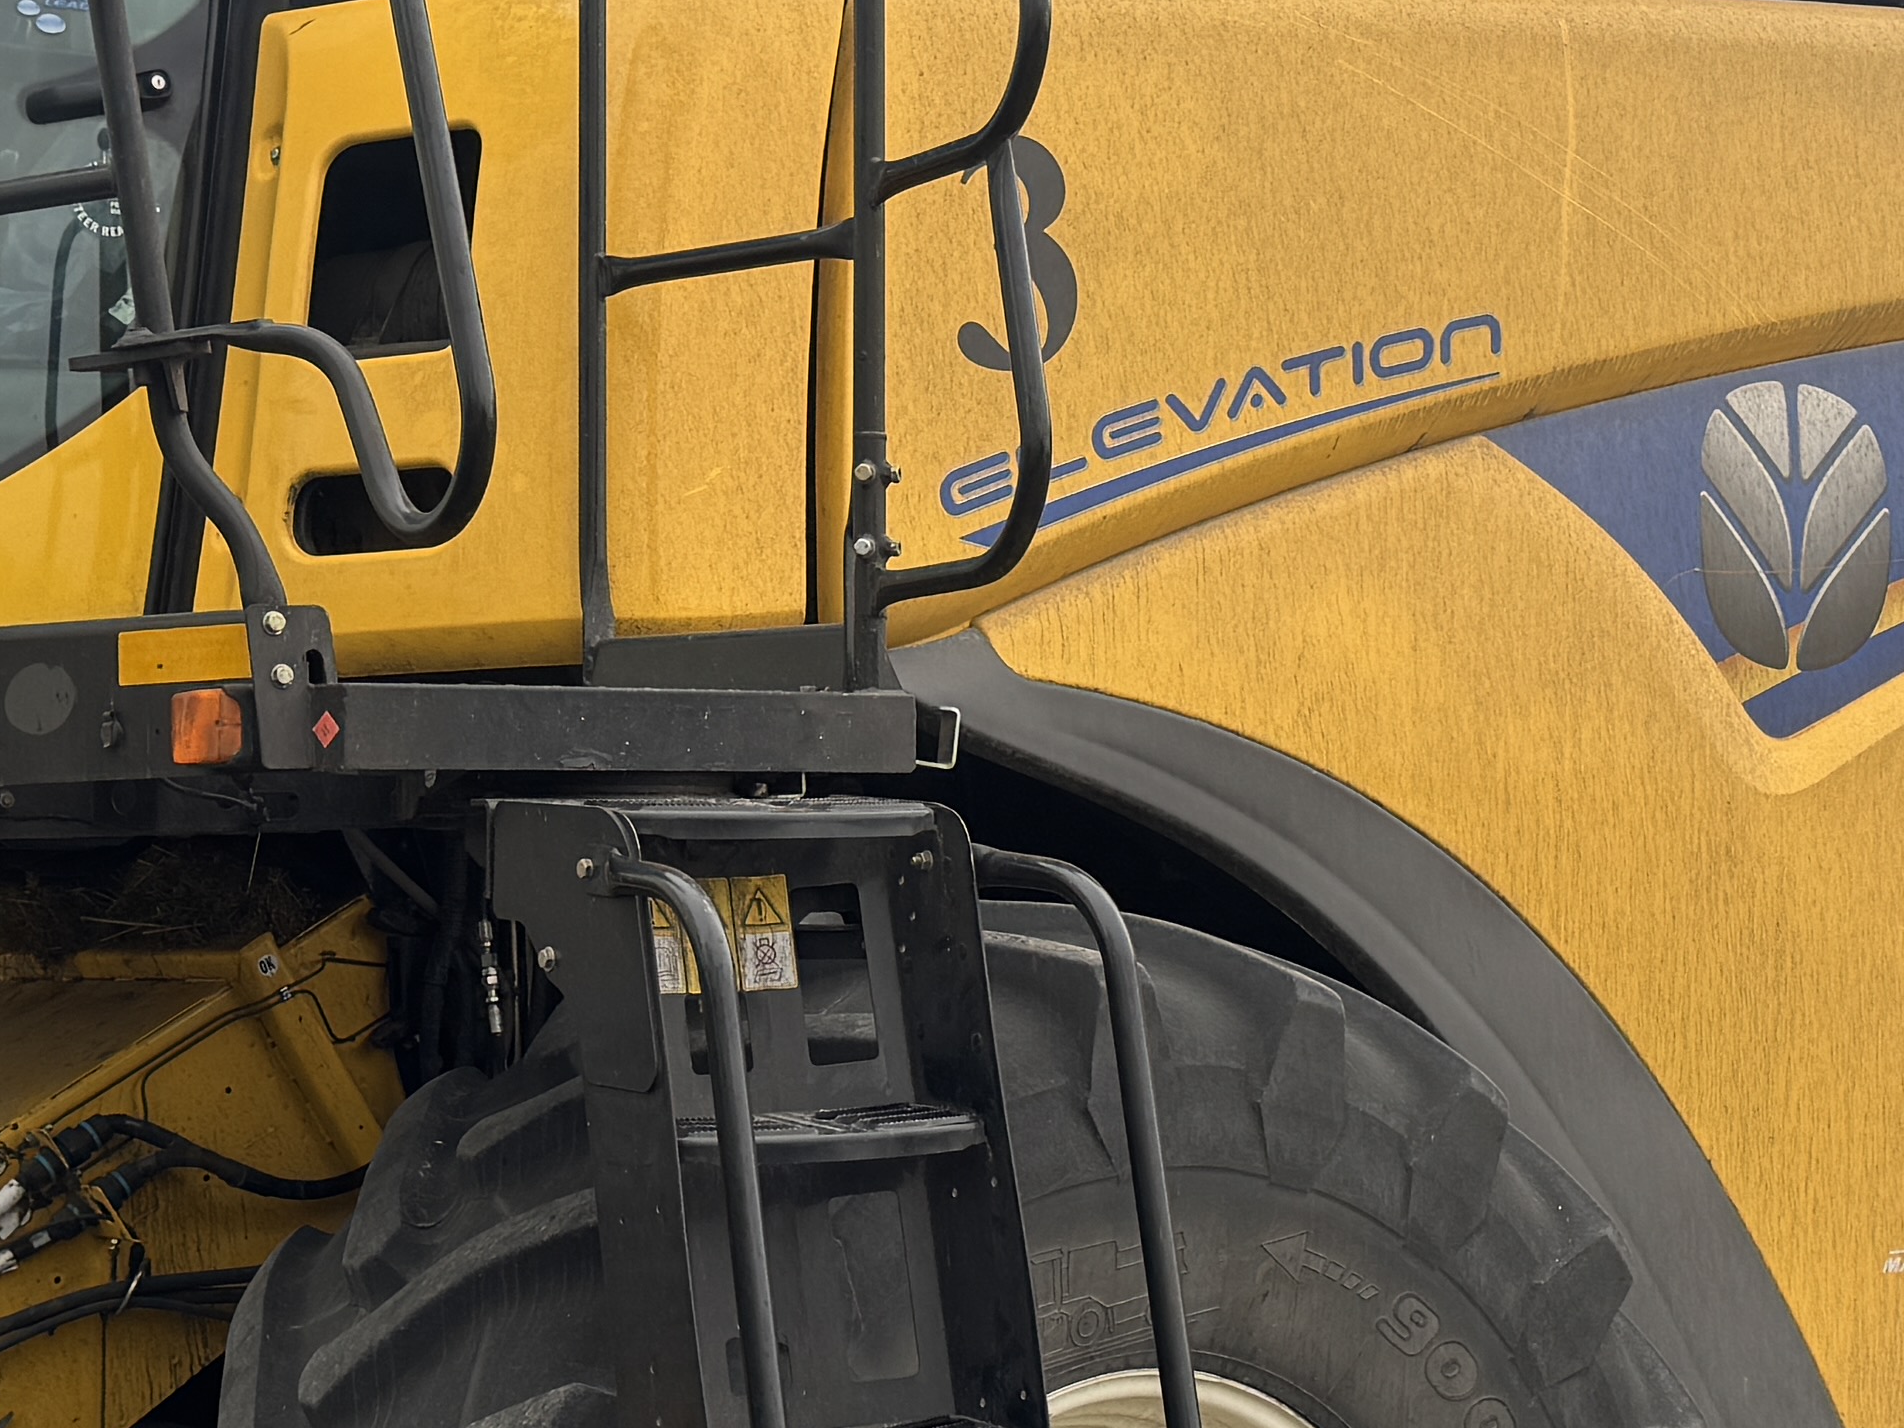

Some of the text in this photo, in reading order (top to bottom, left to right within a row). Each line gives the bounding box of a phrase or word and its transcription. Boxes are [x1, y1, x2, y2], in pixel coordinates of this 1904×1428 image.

[101, 225, 125, 238] REA
[957, 135, 1078, 371] 3
[940, 312, 1501, 517] ELEVATION
[259, 955, 276, 974] OK
